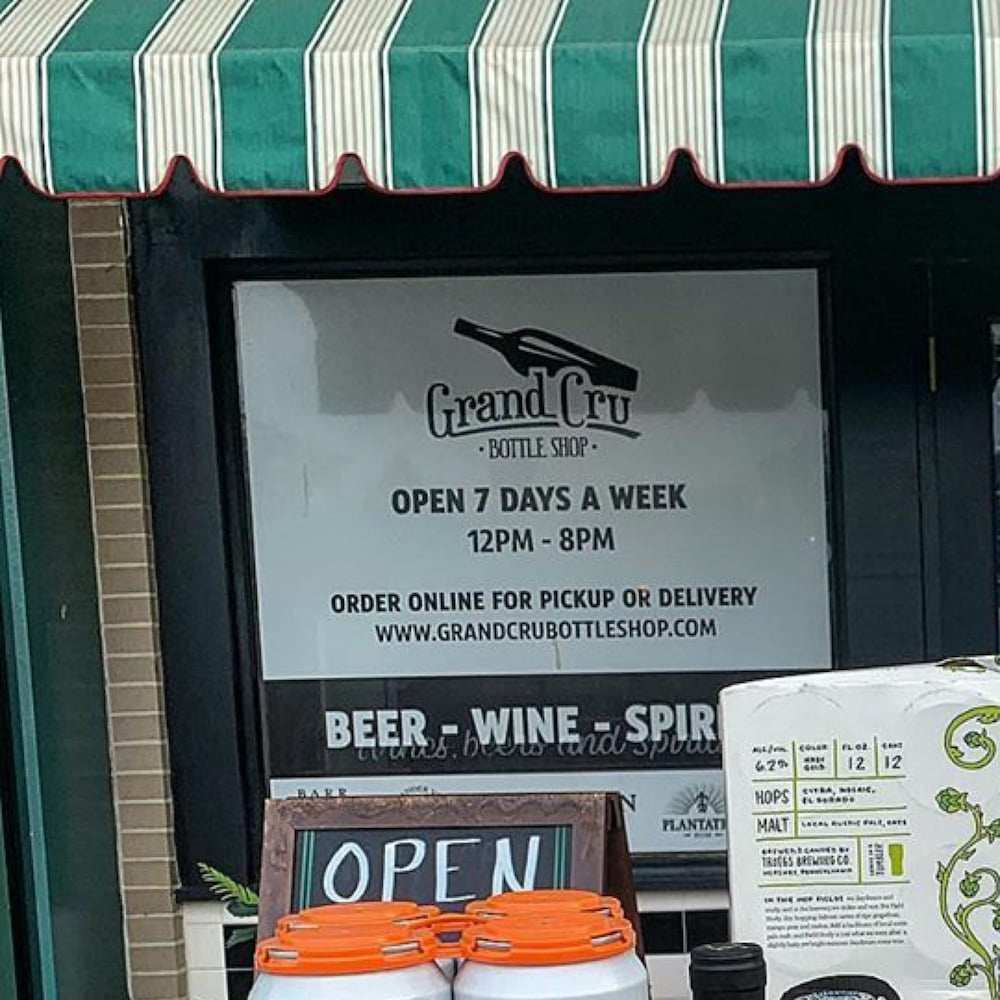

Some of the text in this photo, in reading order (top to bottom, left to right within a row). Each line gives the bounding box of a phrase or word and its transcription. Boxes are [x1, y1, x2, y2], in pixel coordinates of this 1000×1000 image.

[427, 369, 632, 439] Grand Cru
[488, 437, 590, 459] BOTTLE SHOP
[391, 484, 687, 515] OPEN 7 DAYS A WEEK
[467, 527, 615, 553] 12PM 8PM
[331, 586, 758, 613] ORDER ONLINE FOR PICKUP OR DELIVERY
[375, 618, 717, 644] WWW.GRANDCRUBOTTLESHOP.COM
[325, 704, 722, 749] BEER WINE SPIR
[848, 756, 866, 771] 12
[884, 755, 903, 769] 12
[755, 788, 790, 805] HOPS
[662, 818, 728, 832] PLANTATI
[757, 817, 790, 833] MALT
[322, 834, 542, 904] OPEN
